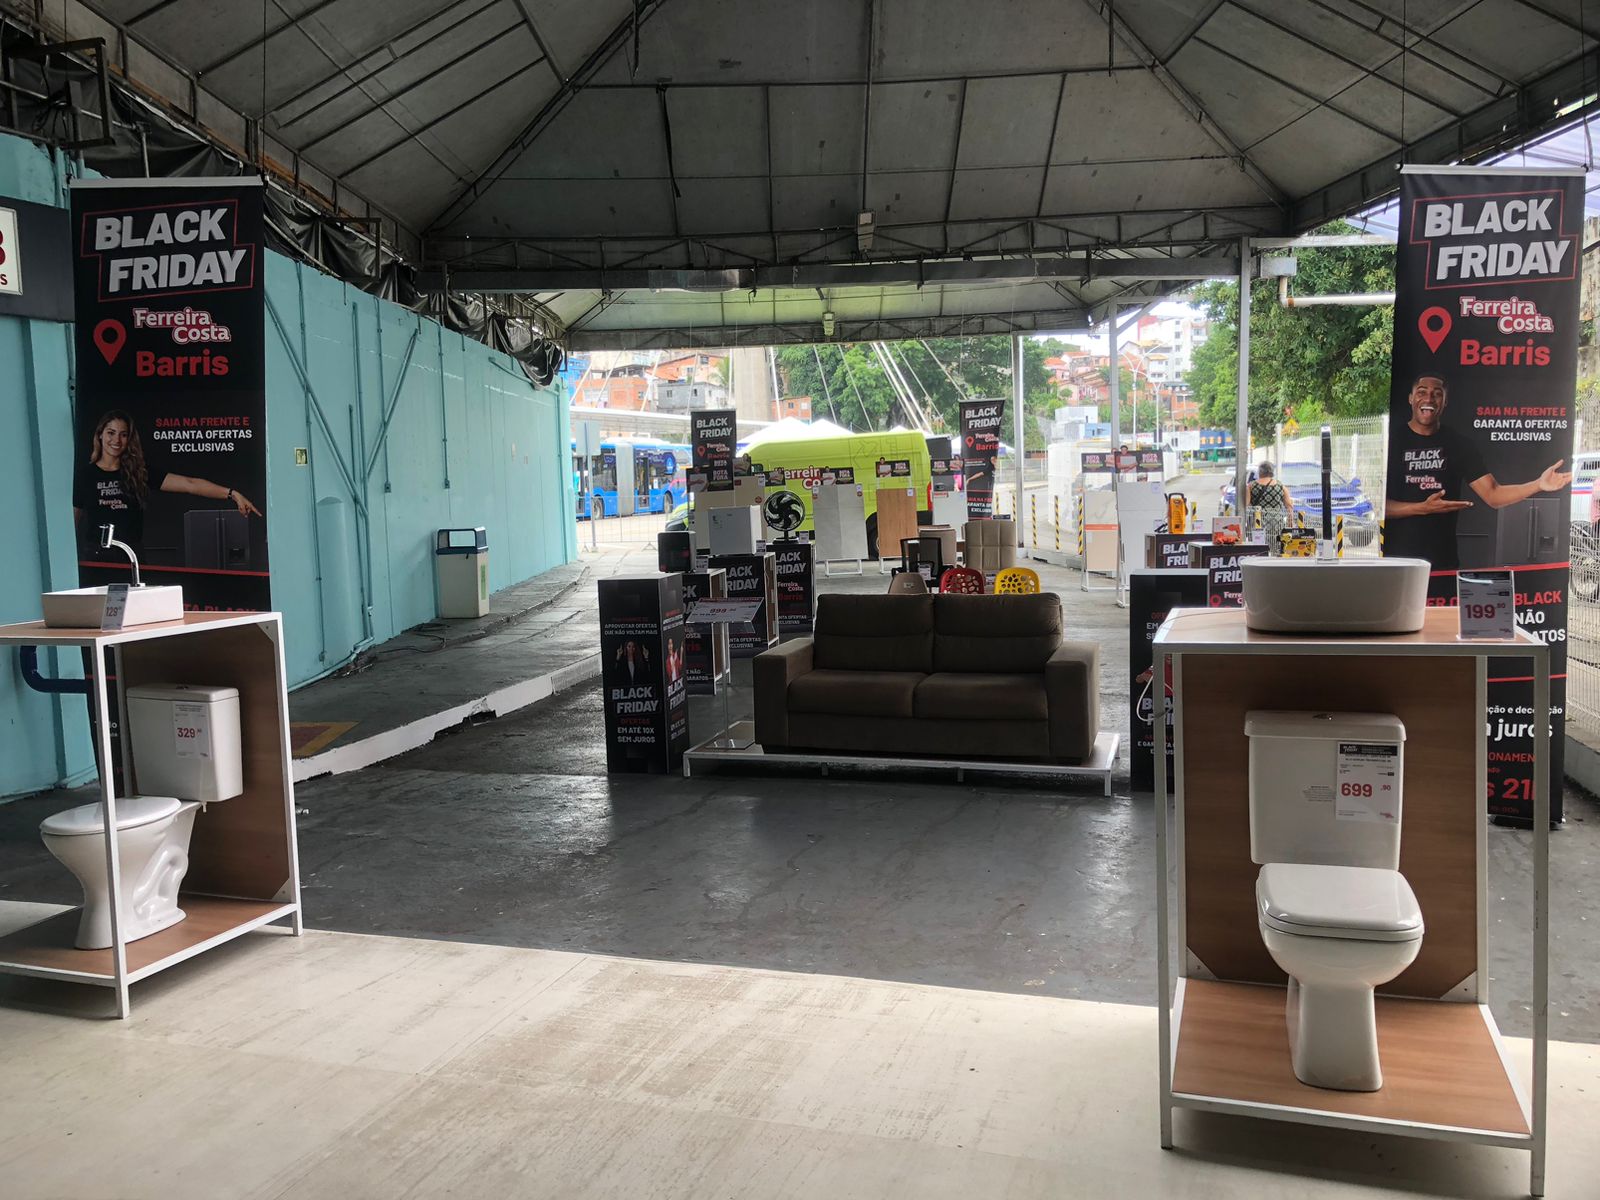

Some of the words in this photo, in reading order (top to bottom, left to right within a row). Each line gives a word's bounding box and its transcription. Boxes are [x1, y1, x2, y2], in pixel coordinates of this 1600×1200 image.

[1424, 198, 1554, 238] BLACK
[95, 208, 228, 251] BLACK
[1436, 240, 1571, 281] FRIDAY
[108, 249, 247, 293] FRIDAY
[1459, 296, 1536, 317] Ferreira
[134, 306, 211, 328] Ferreira
[1498, 315, 1554, 334] Costa
[172, 326, 230, 344] Costa
[1460, 338, 1551, 366] Barris
[136, 348, 229, 377] Barris
[965, 406, 998, 419] BLACK
[1476, 407, 1501, 417] SAIA
[1504, 407, 1518, 417] NA
[1521, 407, 1559, 417] FRENTE
[1560, 407, 1566, 417] E
[155, 418, 180, 428] SAIA
[184, 417, 198, 427] NA
[200, 417, 240, 427] FRENTE
[243, 417, 249, 427] E
[696, 417, 728, 429] BLACK
[969, 417, 1002, 429] FRIDAY
[1473, 419, 1522, 430] GARANTA
[1524, 419, 1568, 430] OFERTAS
[153, 429, 204, 440] GARANTA
[205, 429, 253, 440] OFERTAS
[700, 427, 733, 439] FRIDAY
[1490, 431, 1552, 442] EXCLUSIVAS
[171, 442, 234, 453] EXCLUSIVAS
[1404, 449, 1441, 462] BLACK
[1408, 459, 1445, 471] FRIDAY
[785, 466, 820, 479] erreir
[97, 480, 119, 490] BLAC
[1405, 475, 1436, 484] Ferreira
[1420, 481, 1443, 490] Costa
[1163, 544, 1188, 554] BLA
[726, 565, 753, 578] ACK
[776, 563, 807, 575] RIDAY
[1214, 569, 1242, 583] FRID
[727, 578, 759, 591] RIDAY
[1514, 591, 1562, 606] BLACK
[106, 607, 118, 617] 129
[1464, 604, 1496, 619] 199
[1514, 609, 1545, 625] NÃO
[1532, 628, 1567, 643] ATOS
[612, 686, 653, 700] BLACK
[616, 700, 659, 714] FRIDAY
[177, 727, 195, 738] 329
[628, 725, 641, 734] ATÉ
[1488, 752, 1535, 763] ONAMEN
[1341, 783, 1373, 797] 699
[1503, 778, 1535, 800] 21
